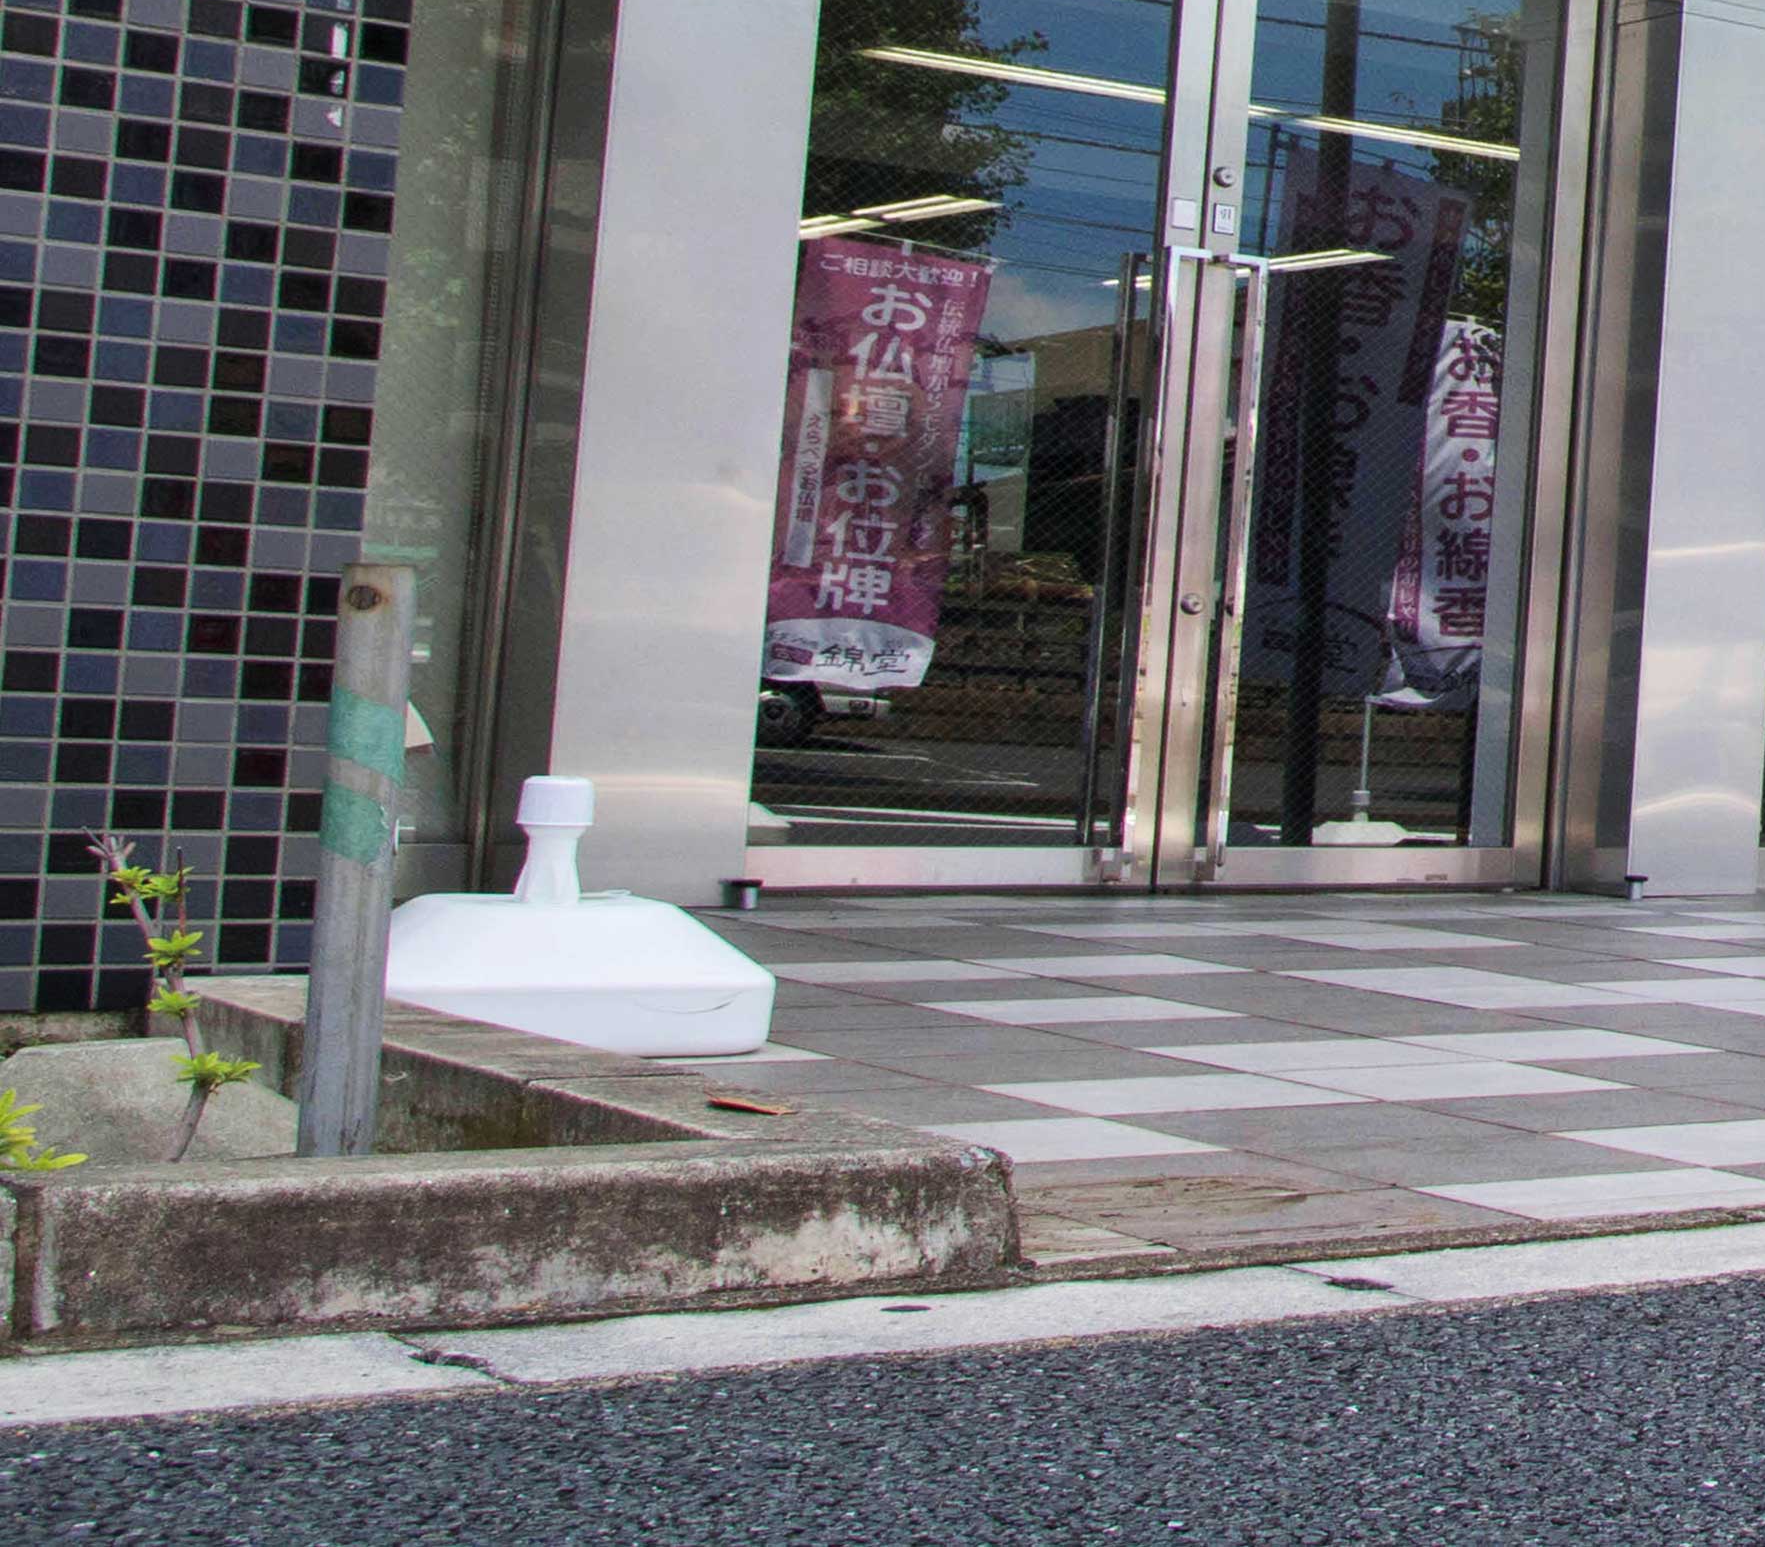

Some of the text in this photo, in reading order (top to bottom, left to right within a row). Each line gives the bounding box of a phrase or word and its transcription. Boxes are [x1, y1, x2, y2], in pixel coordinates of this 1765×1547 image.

[814, 284, 933, 615] お仏壇・お位牌
[815, 643, 911, 677] 錦堂
